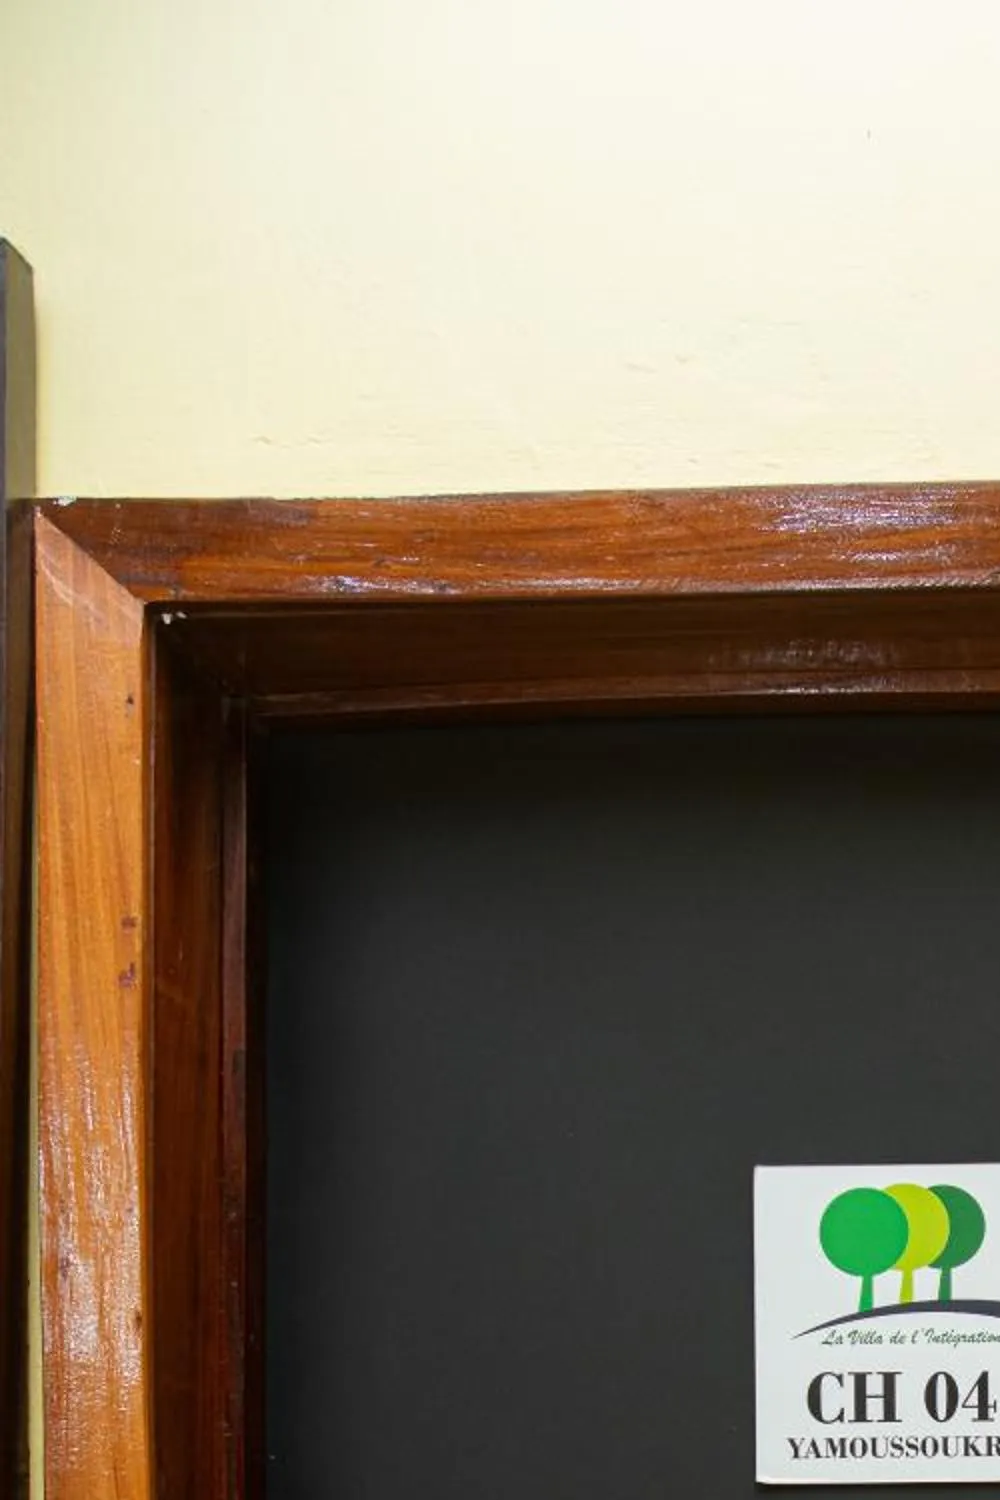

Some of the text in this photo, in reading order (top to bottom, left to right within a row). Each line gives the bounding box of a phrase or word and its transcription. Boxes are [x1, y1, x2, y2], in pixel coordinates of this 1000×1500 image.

[821, 1329, 843, 1346] La
[847, 1328, 884, 1345] Villa
[889, 1329, 906, 1345] de
[807, 1371, 997, 1424] CH 04
